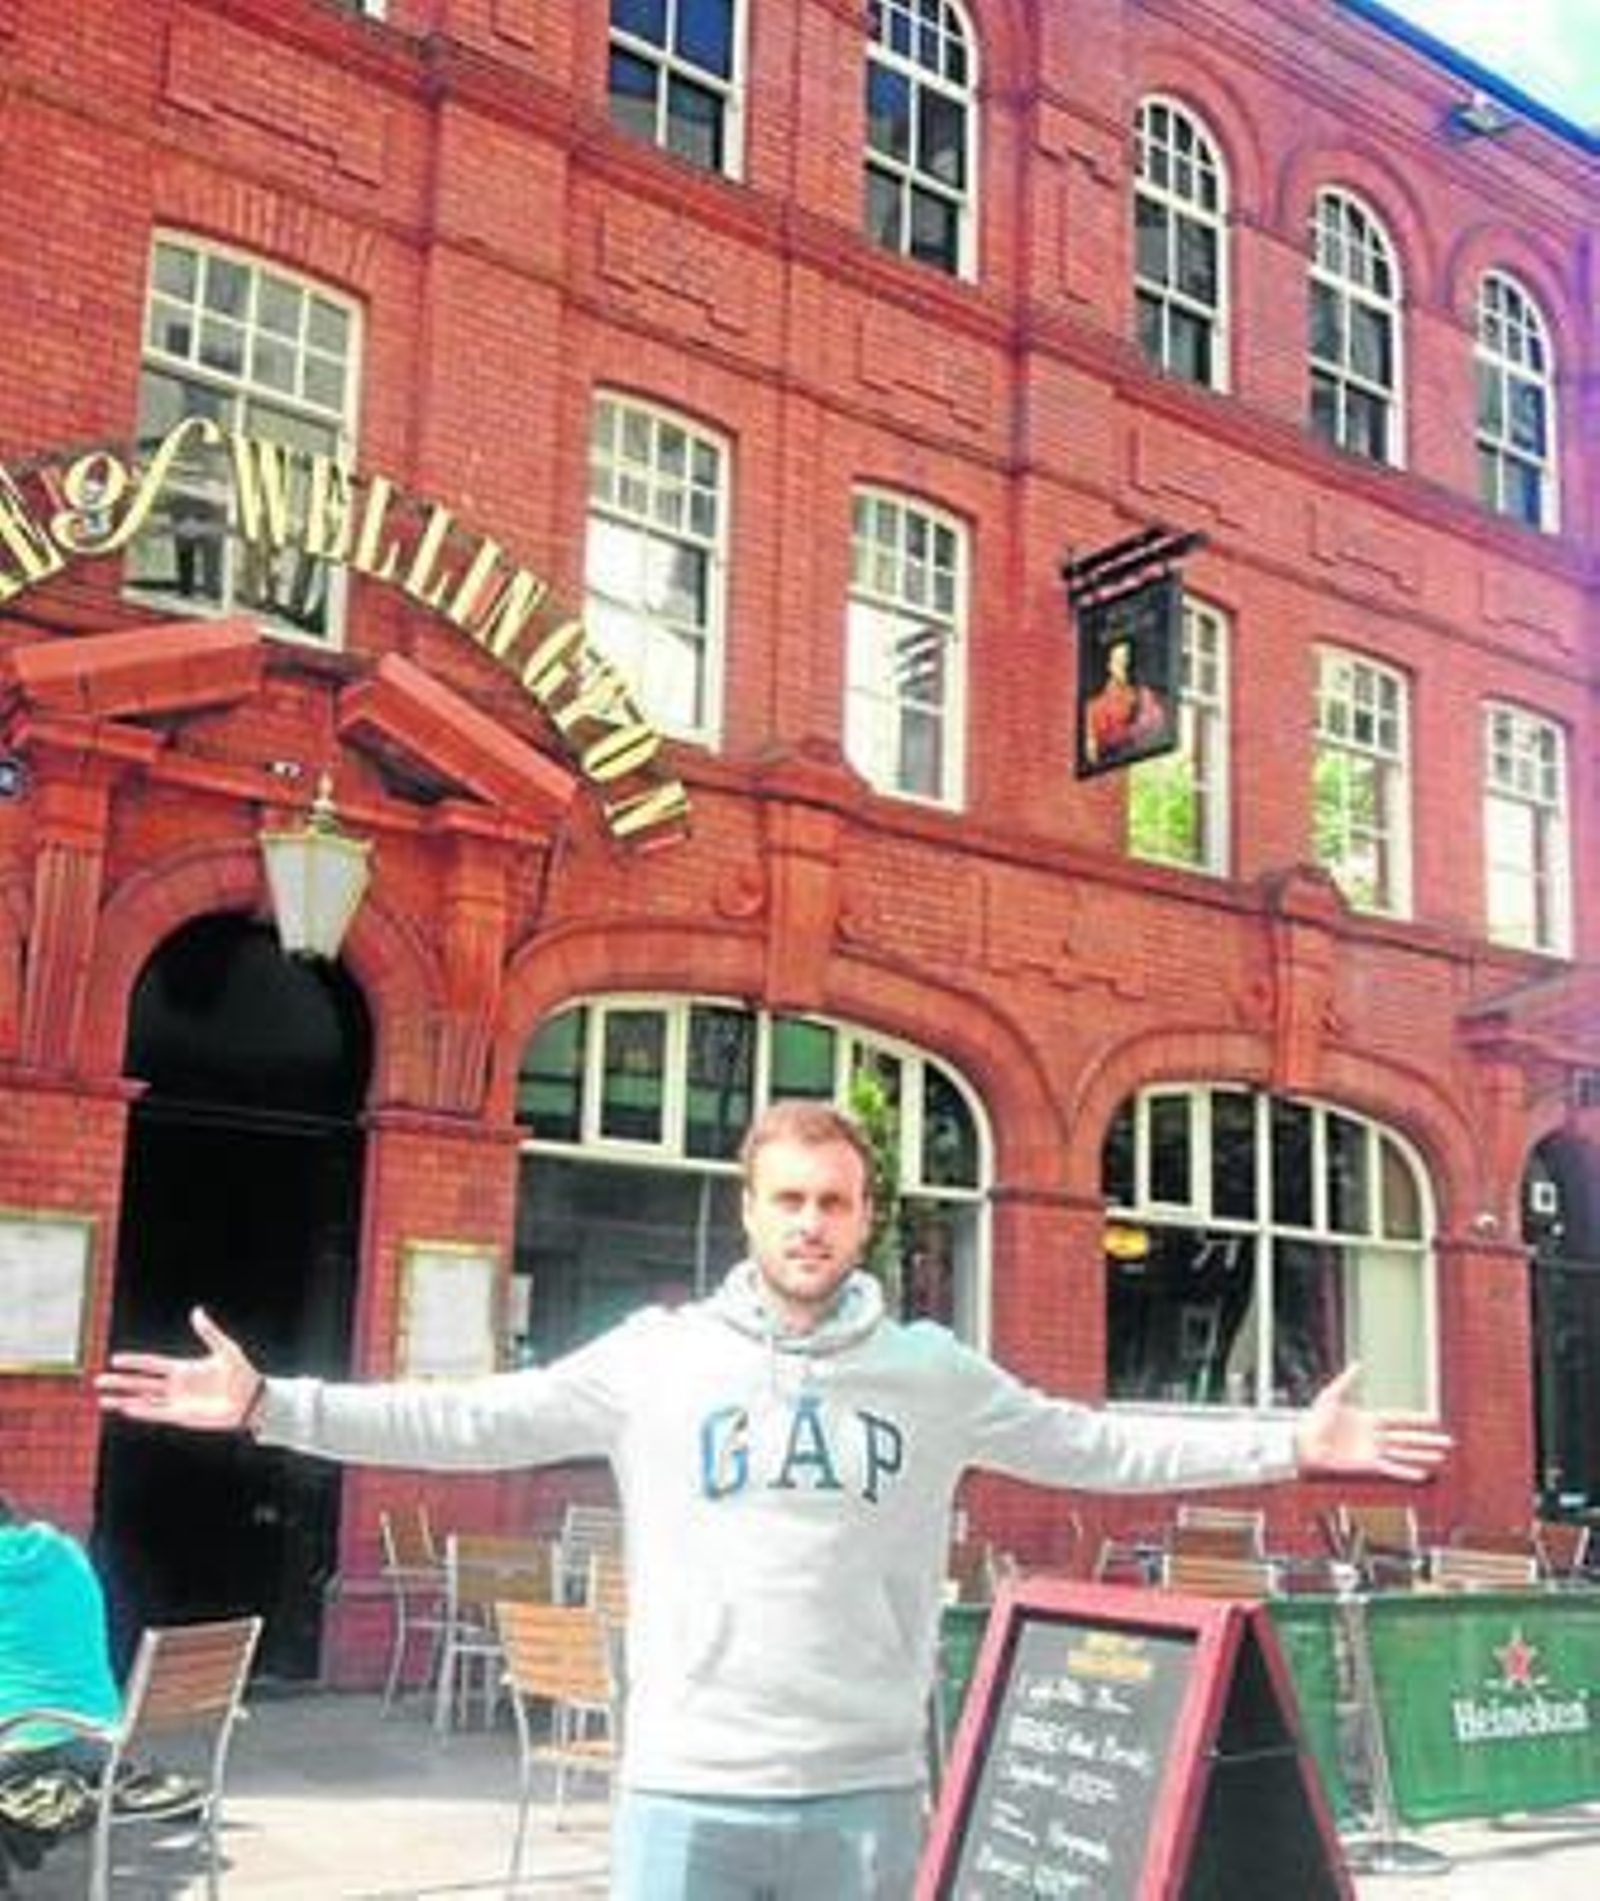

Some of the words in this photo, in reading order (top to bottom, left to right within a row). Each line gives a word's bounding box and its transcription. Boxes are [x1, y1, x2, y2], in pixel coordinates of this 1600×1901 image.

[52, 417, 220, 553] of
[231, 434, 690, 836] WELLINGTON
[702, 1396, 903, 1504] GAP
[1454, 1693, 1588, 1742] Heineken
